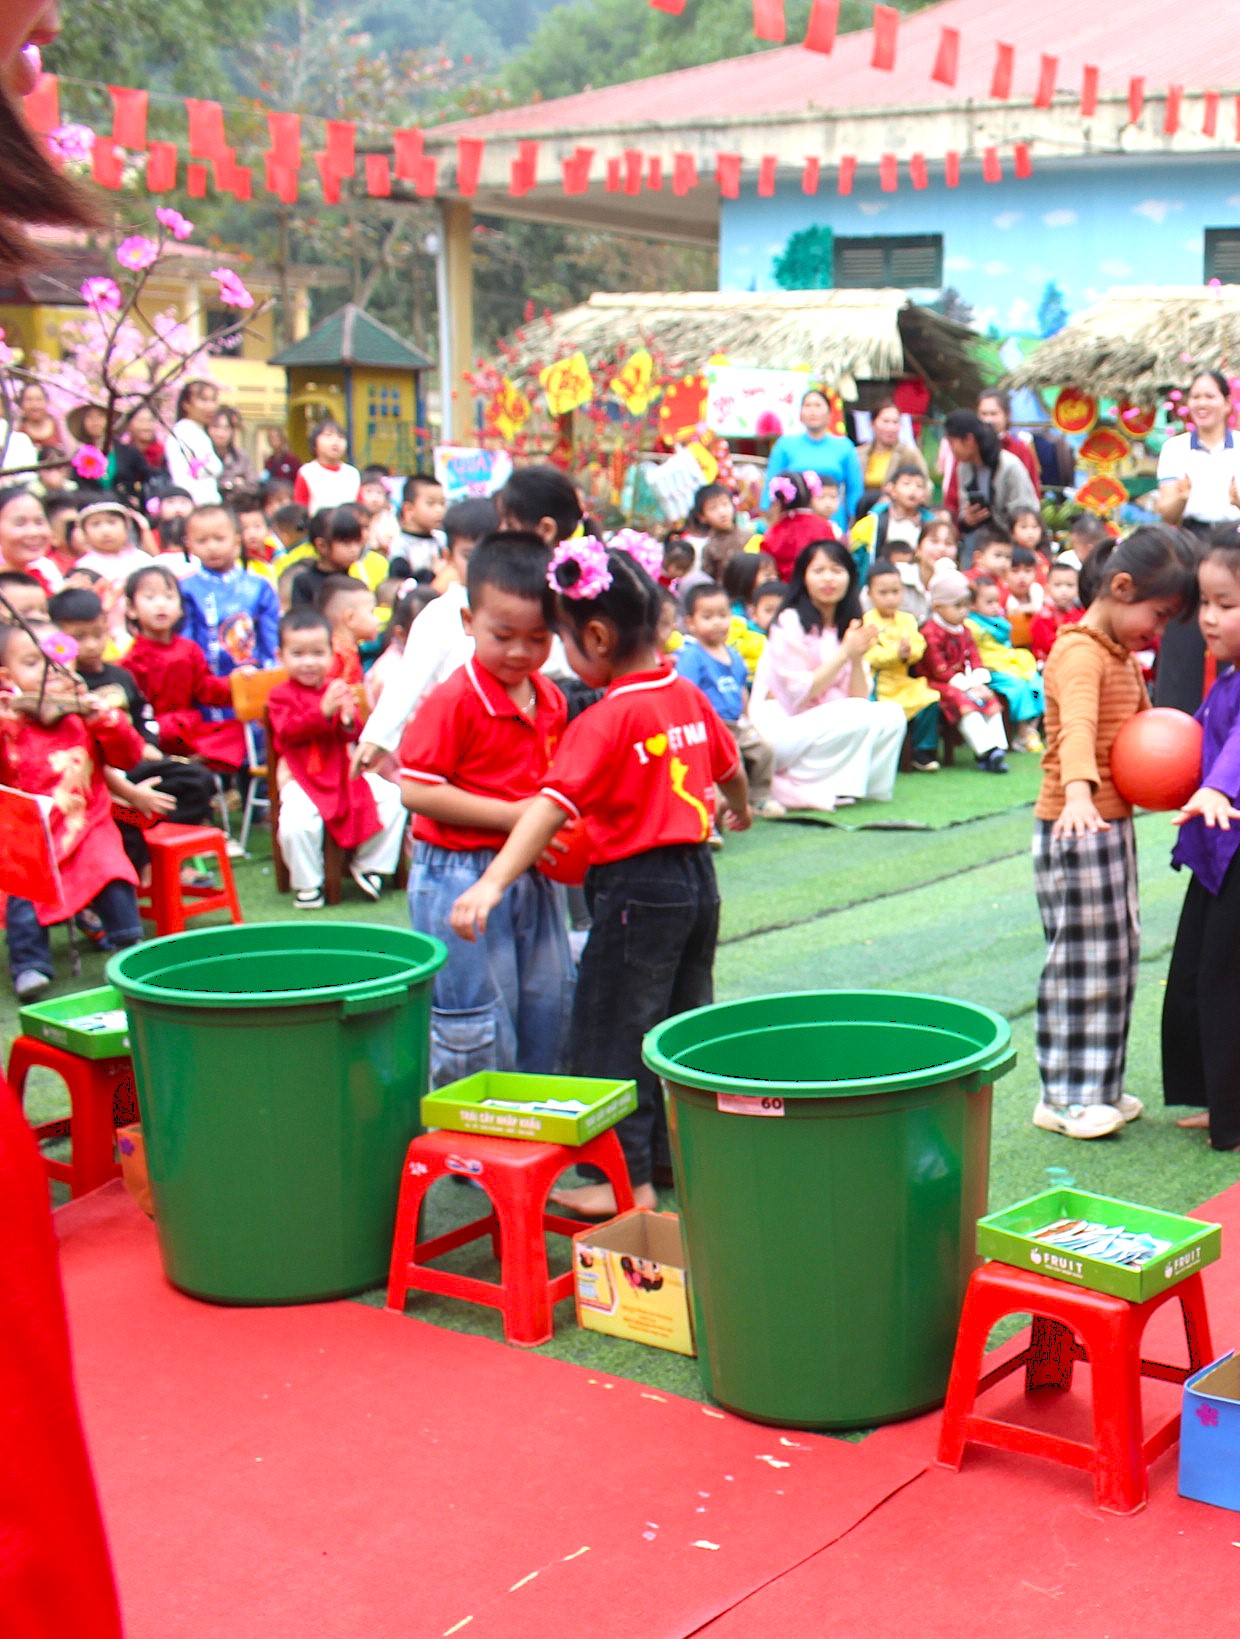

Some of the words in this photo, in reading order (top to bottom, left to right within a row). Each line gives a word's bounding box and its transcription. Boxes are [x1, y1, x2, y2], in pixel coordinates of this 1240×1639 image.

[761, 1097, 782, 1110] 60
[1044, 1252, 1083, 1274] FRUIT
[1174, 1246, 1201, 1271] FRUIT
